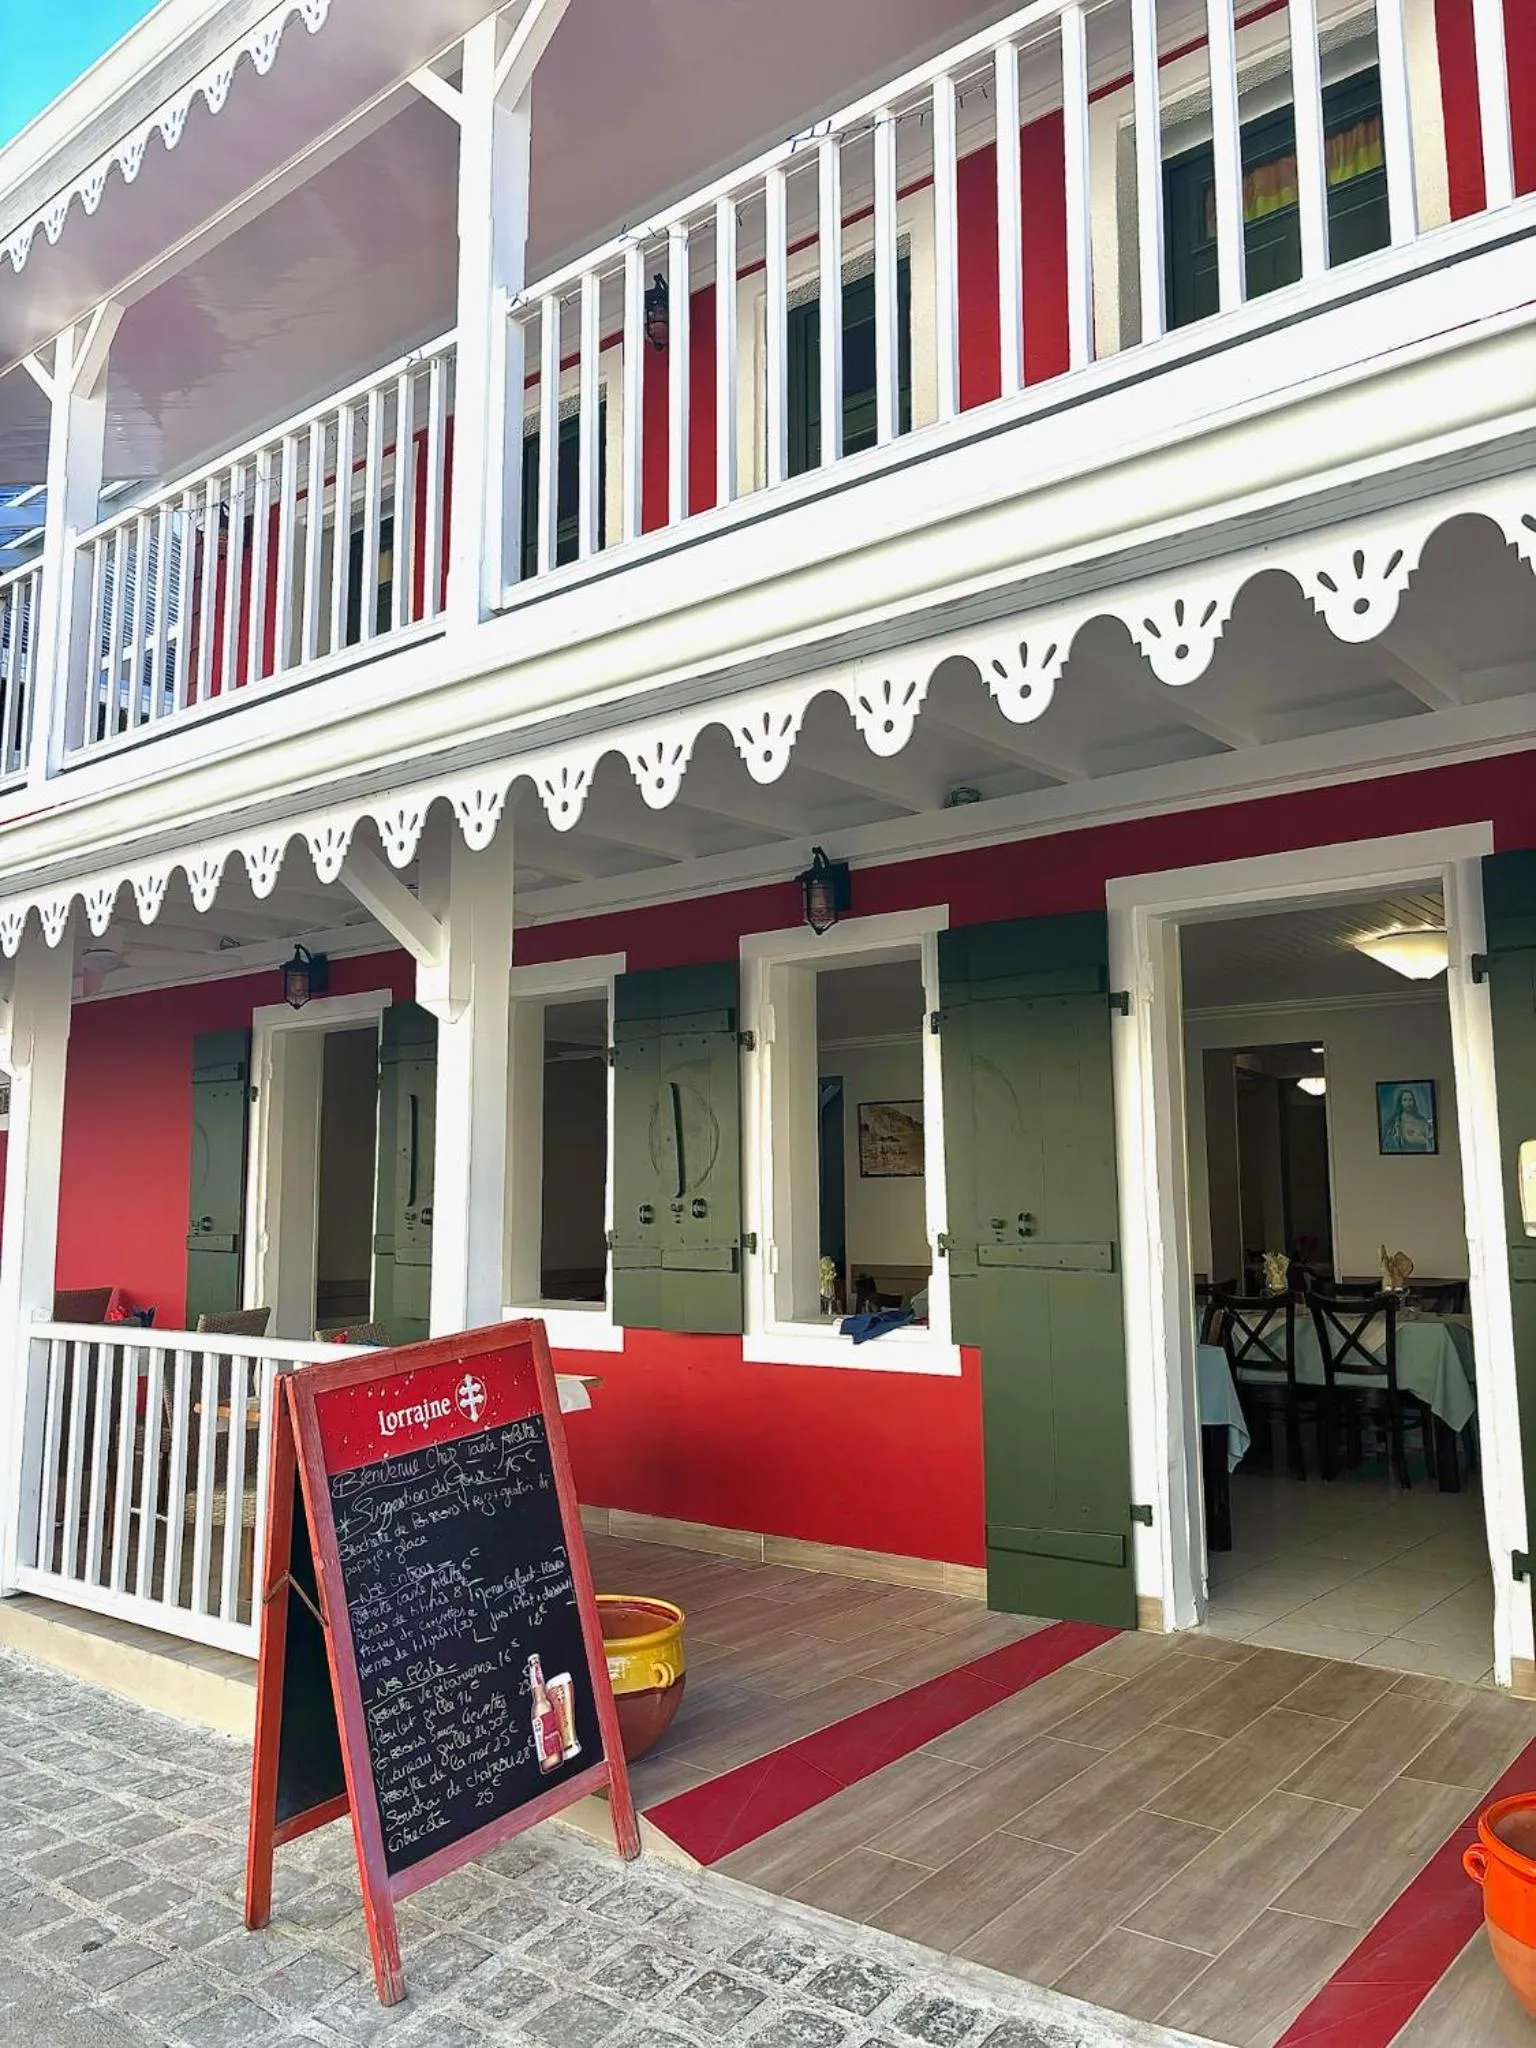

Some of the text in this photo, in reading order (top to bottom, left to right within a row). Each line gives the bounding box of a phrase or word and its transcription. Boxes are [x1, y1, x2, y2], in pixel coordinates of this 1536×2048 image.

[377, 1398, 452, 1436] Lorraine
[351, 1488, 430, 1532] Suggestion
[431, 1477, 451, 1498] du
[394, 1521, 409, 1538] de
